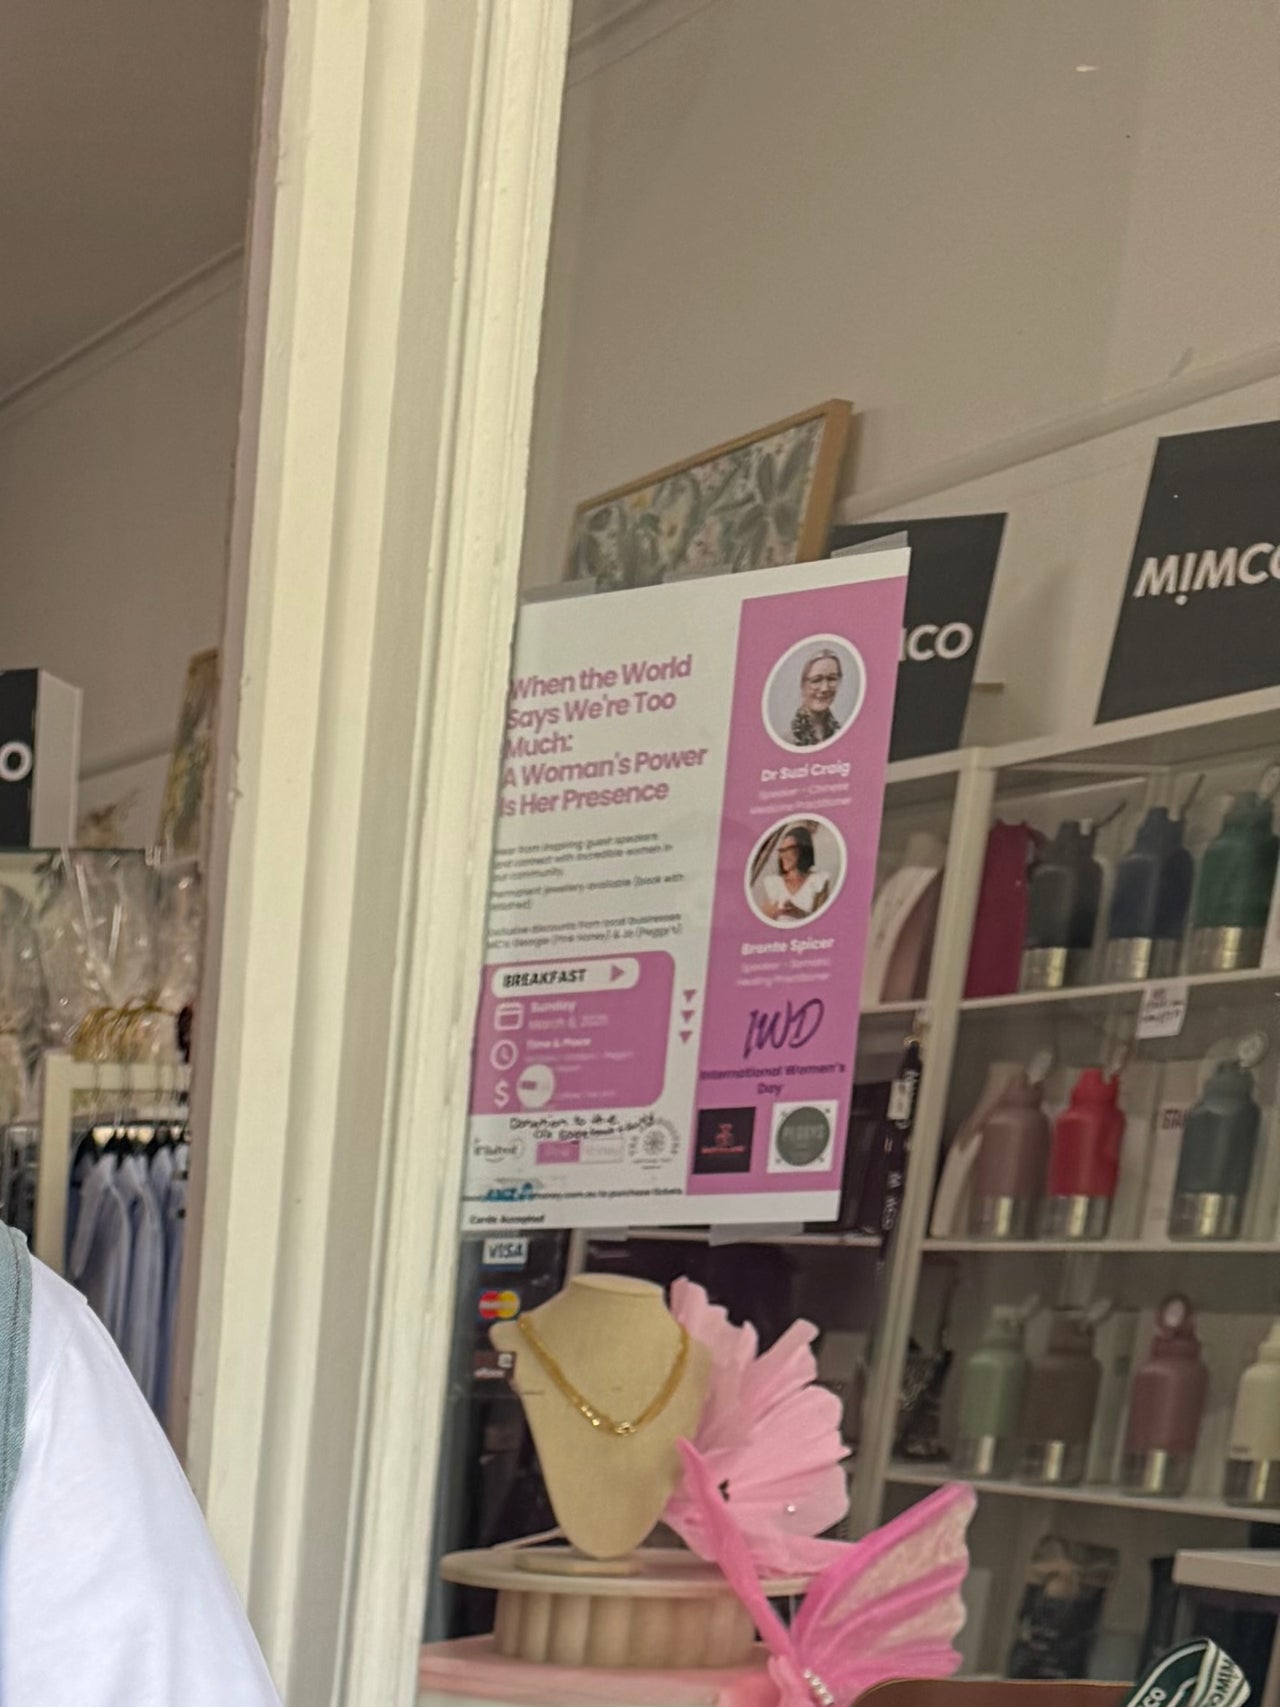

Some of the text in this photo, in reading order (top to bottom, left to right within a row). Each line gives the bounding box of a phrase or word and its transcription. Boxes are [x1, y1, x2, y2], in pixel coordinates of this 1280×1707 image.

[1132, 542, 1280, 606] MIMC
[511, 654, 693, 700] When the World
[507, 691, 677, 733] Says We're Too
[504, 731, 573, 759] Much:
[502, 749, 708, 788] A Woman's Power
[761, 769, 778, 782] Dr
[499, 782, 670, 818] Is Her Presence
[503, 968, 588, 988] BREAKFAST
[743, 998, 825, 1059] IWD
[700, 1063, 847, 1080] International Women's
[757, 1082, 785, 1096] Day
[488, 1242, 524, 1259] VISA
